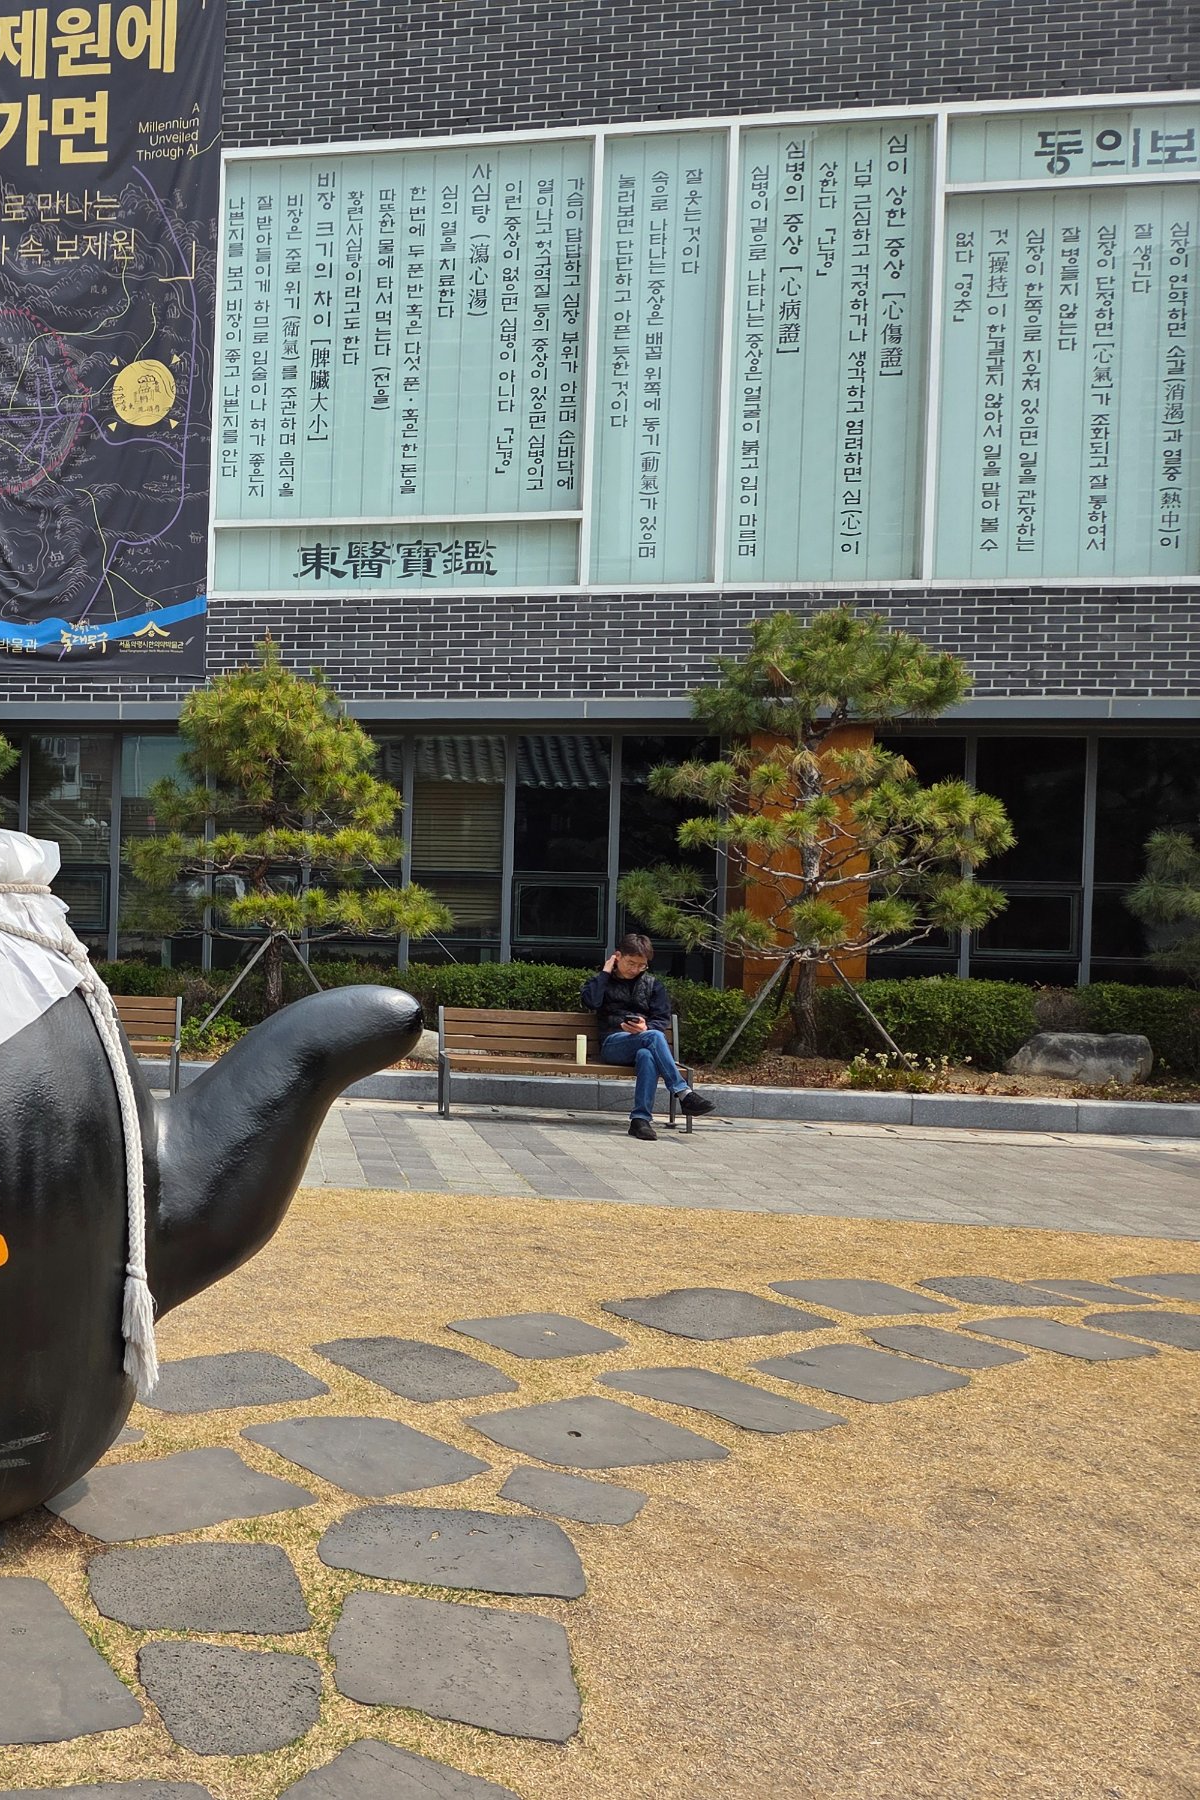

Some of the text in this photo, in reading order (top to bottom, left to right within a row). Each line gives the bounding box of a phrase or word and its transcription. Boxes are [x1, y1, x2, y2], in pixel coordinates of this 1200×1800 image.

[138, 117, 200, 133] Millennium
[191, 102, 200, 114] A
[136, 144, 198, 162] Through AI
[149, 130, 199, 146] Unveiled
[886, 133, 908, 175] 심이
[1034, 128, 1197, 175] 동의보
[317, 171, 336, 211] 비장
[471, 163, 493, 224] 사심탕
[685, 168, 704, 185] 잘
[783, 139, 806, 202] 심병의
[818, 161, 839, 210] 상한다
[37, 189, 121, 222] 만나는
[378, 188, 396, 234] 따뜻한
[504, 179, 522, 211] 이런
[885, 185, 908, 228] 상한
[18, 235, 45, 265] 속
[53, 228, 135, 262] 보제원
[314, 221, 335, 279] 크기의
[377, 238, 395, 270] 물에
[408, 244, 425, 258] 두
[437, 184, 459, 319] 심의 열을 치료한다
[502, 215, 522, 262] 증상이
[681, 226, 701, 275] 것이다
[782, 213, 804, 256] 증상
[955, 231, 975, 264] 없다
[1096, 224, 1117, 270] 심장이
[613, 239, 635, 303] 단단하고
[883, 237, 906, 280] 증상
[1131, 222, 1154, 294] 잘 생긴다
[1167, 221, 1190, 338] 심장이 연약하면
[312, 289, 333, 328] 차이
[375, 275, 394, 305] 타서
[406, 283, 424, 299] 반
[501, 266, 520, 313] 없으면
[1057, 226, 1081, 352] 잘 병들지 않는다
[221, 196, 246, 478] 나쁜지를 보고 비장이 좋고 나쁜지를 안다
[374, 309, 392, 357] 먹는다
[404, 303, 423, 336] 혹은
[499, 316, 518, 363] 심병이
[556, 177, 585, 491] 가슴이 답답하고 심장 부위가 아프며 손바닥에
[613, 309, 632, 341] 아픈
[843, 159, 873, 483] 너무 근심하고 걱정하거나 생각하고 염려하면
[247, 194, 273, 498] 잘 받아들이게 하므로 입술이나 혀가 좋은지
[277, 193, 304, 498] 비장은 주로 주관하며 음식을
[342, 335, 361, 366] 한다
[403, 340, 422, 372] 다섯
[526, 239, 553, 491] 헛구역질 등의 증상이 있으면 심병이고
[611, 345, 631, 377] 듯한
[638, 170, 669, 559] 속으로 나타나는 증상은 배꼽 위쪽에 있으며
[737, 164, 770, 558] 심병이 겉으로 나타나는 증상은 얼굴이 붉고 입이 마르며
[497, 369, 517, 413] 아니다
[609, 380, 629, 428] 것이다
[1015, 227, 1046, 552] 심장이 한쪽으로 치우쳐 있으면 일을 관장하는
[401, 408, 419, 439] 혹은
[980, 323, 1006, 552] 한결같지 않아서 일을 맡아 볼 수
[1089, 413, 1111, 469] 조화되고
[399, 463, 417, 495] 돈을
[1089, 474, 1109, 490] 잘
[1086, 494, 1108, 552] 통하여서
[293, 539, 499, 580] 東醫寶鑑
